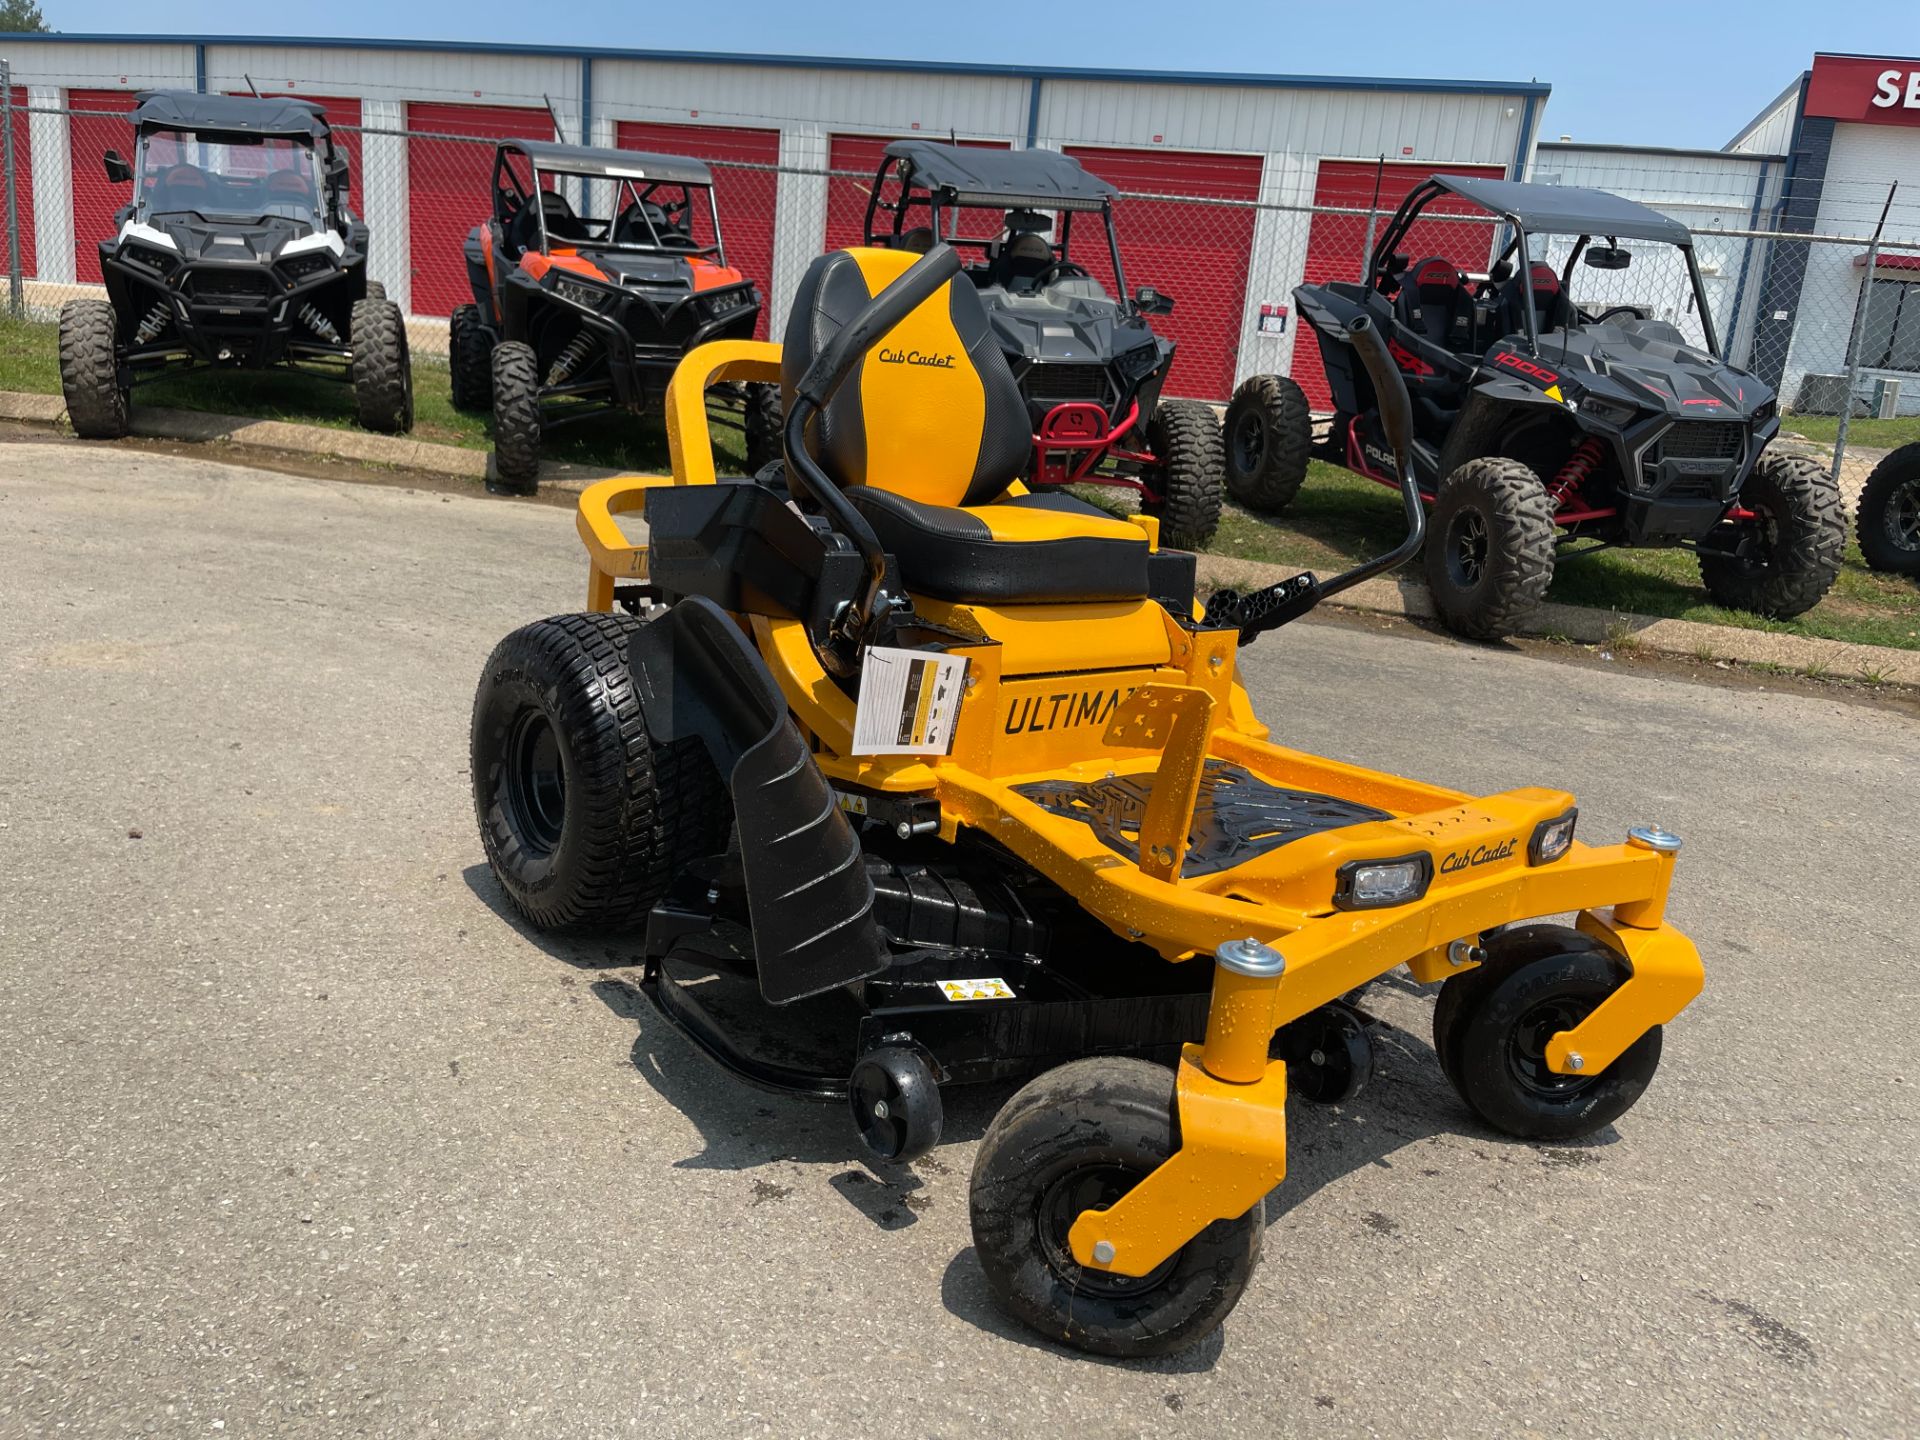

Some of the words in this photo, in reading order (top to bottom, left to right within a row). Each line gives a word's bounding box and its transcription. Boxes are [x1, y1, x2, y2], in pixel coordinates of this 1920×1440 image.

[1871, 69, 1920, 109] SE
[878, 348, 905, 364] Cub
[907, 350, 957, 369] Cadet
[1004, 687, 1136, 735] ULTIMA
[1440, 851, 1470, 874] Cub
[1471, 837, 1518, 866] Cadet
